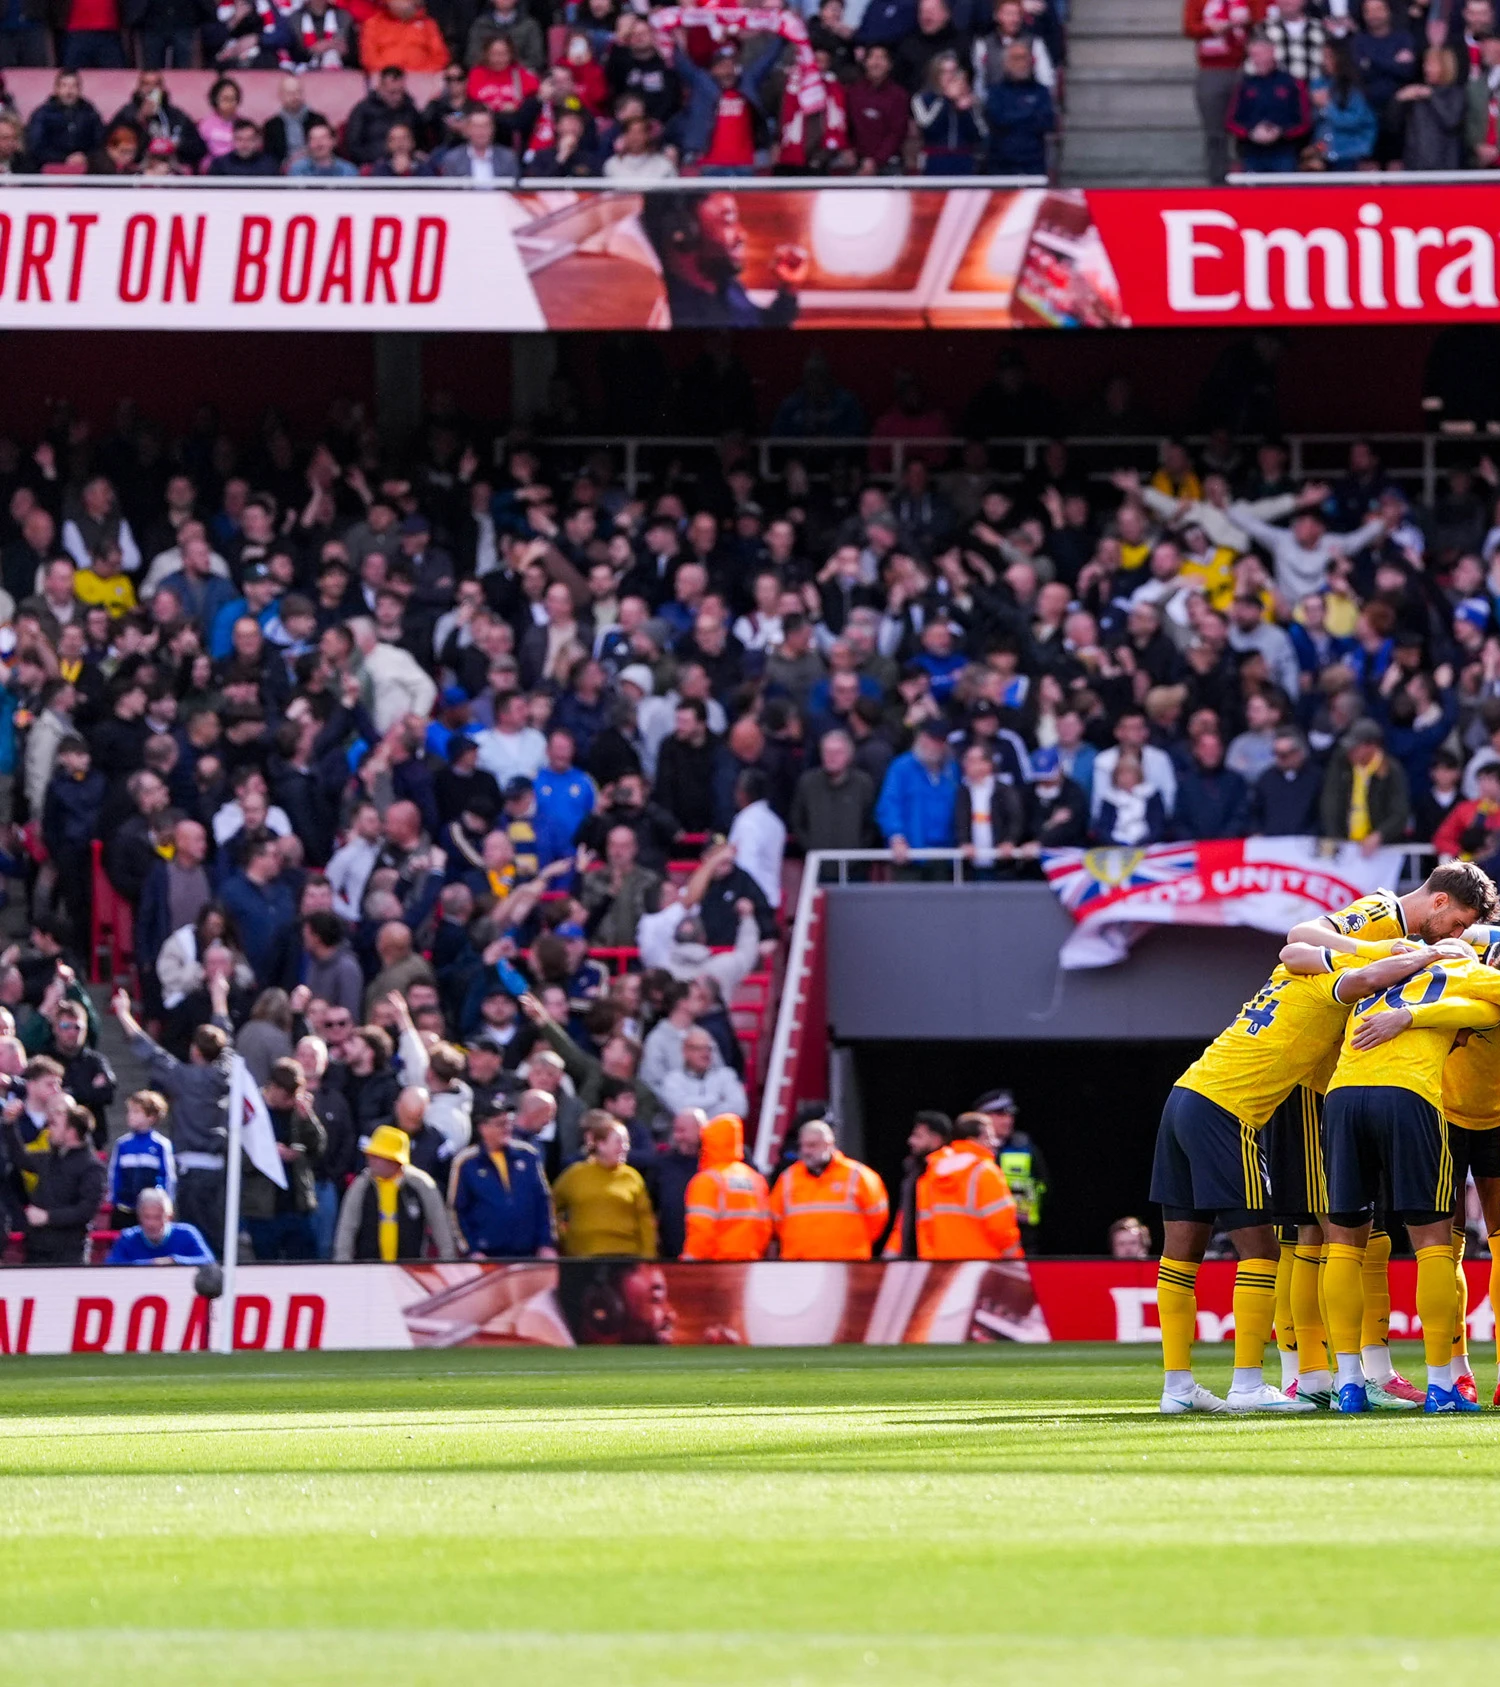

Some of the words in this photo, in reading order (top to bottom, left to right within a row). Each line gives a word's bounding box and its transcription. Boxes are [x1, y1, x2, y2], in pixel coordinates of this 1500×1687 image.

[0, 213, 99, 303] RT
[118, 213, 207, 303] ON
[233, 214, 448, 305] BOARD
[1211, 866, 1355, 912] UNITED
